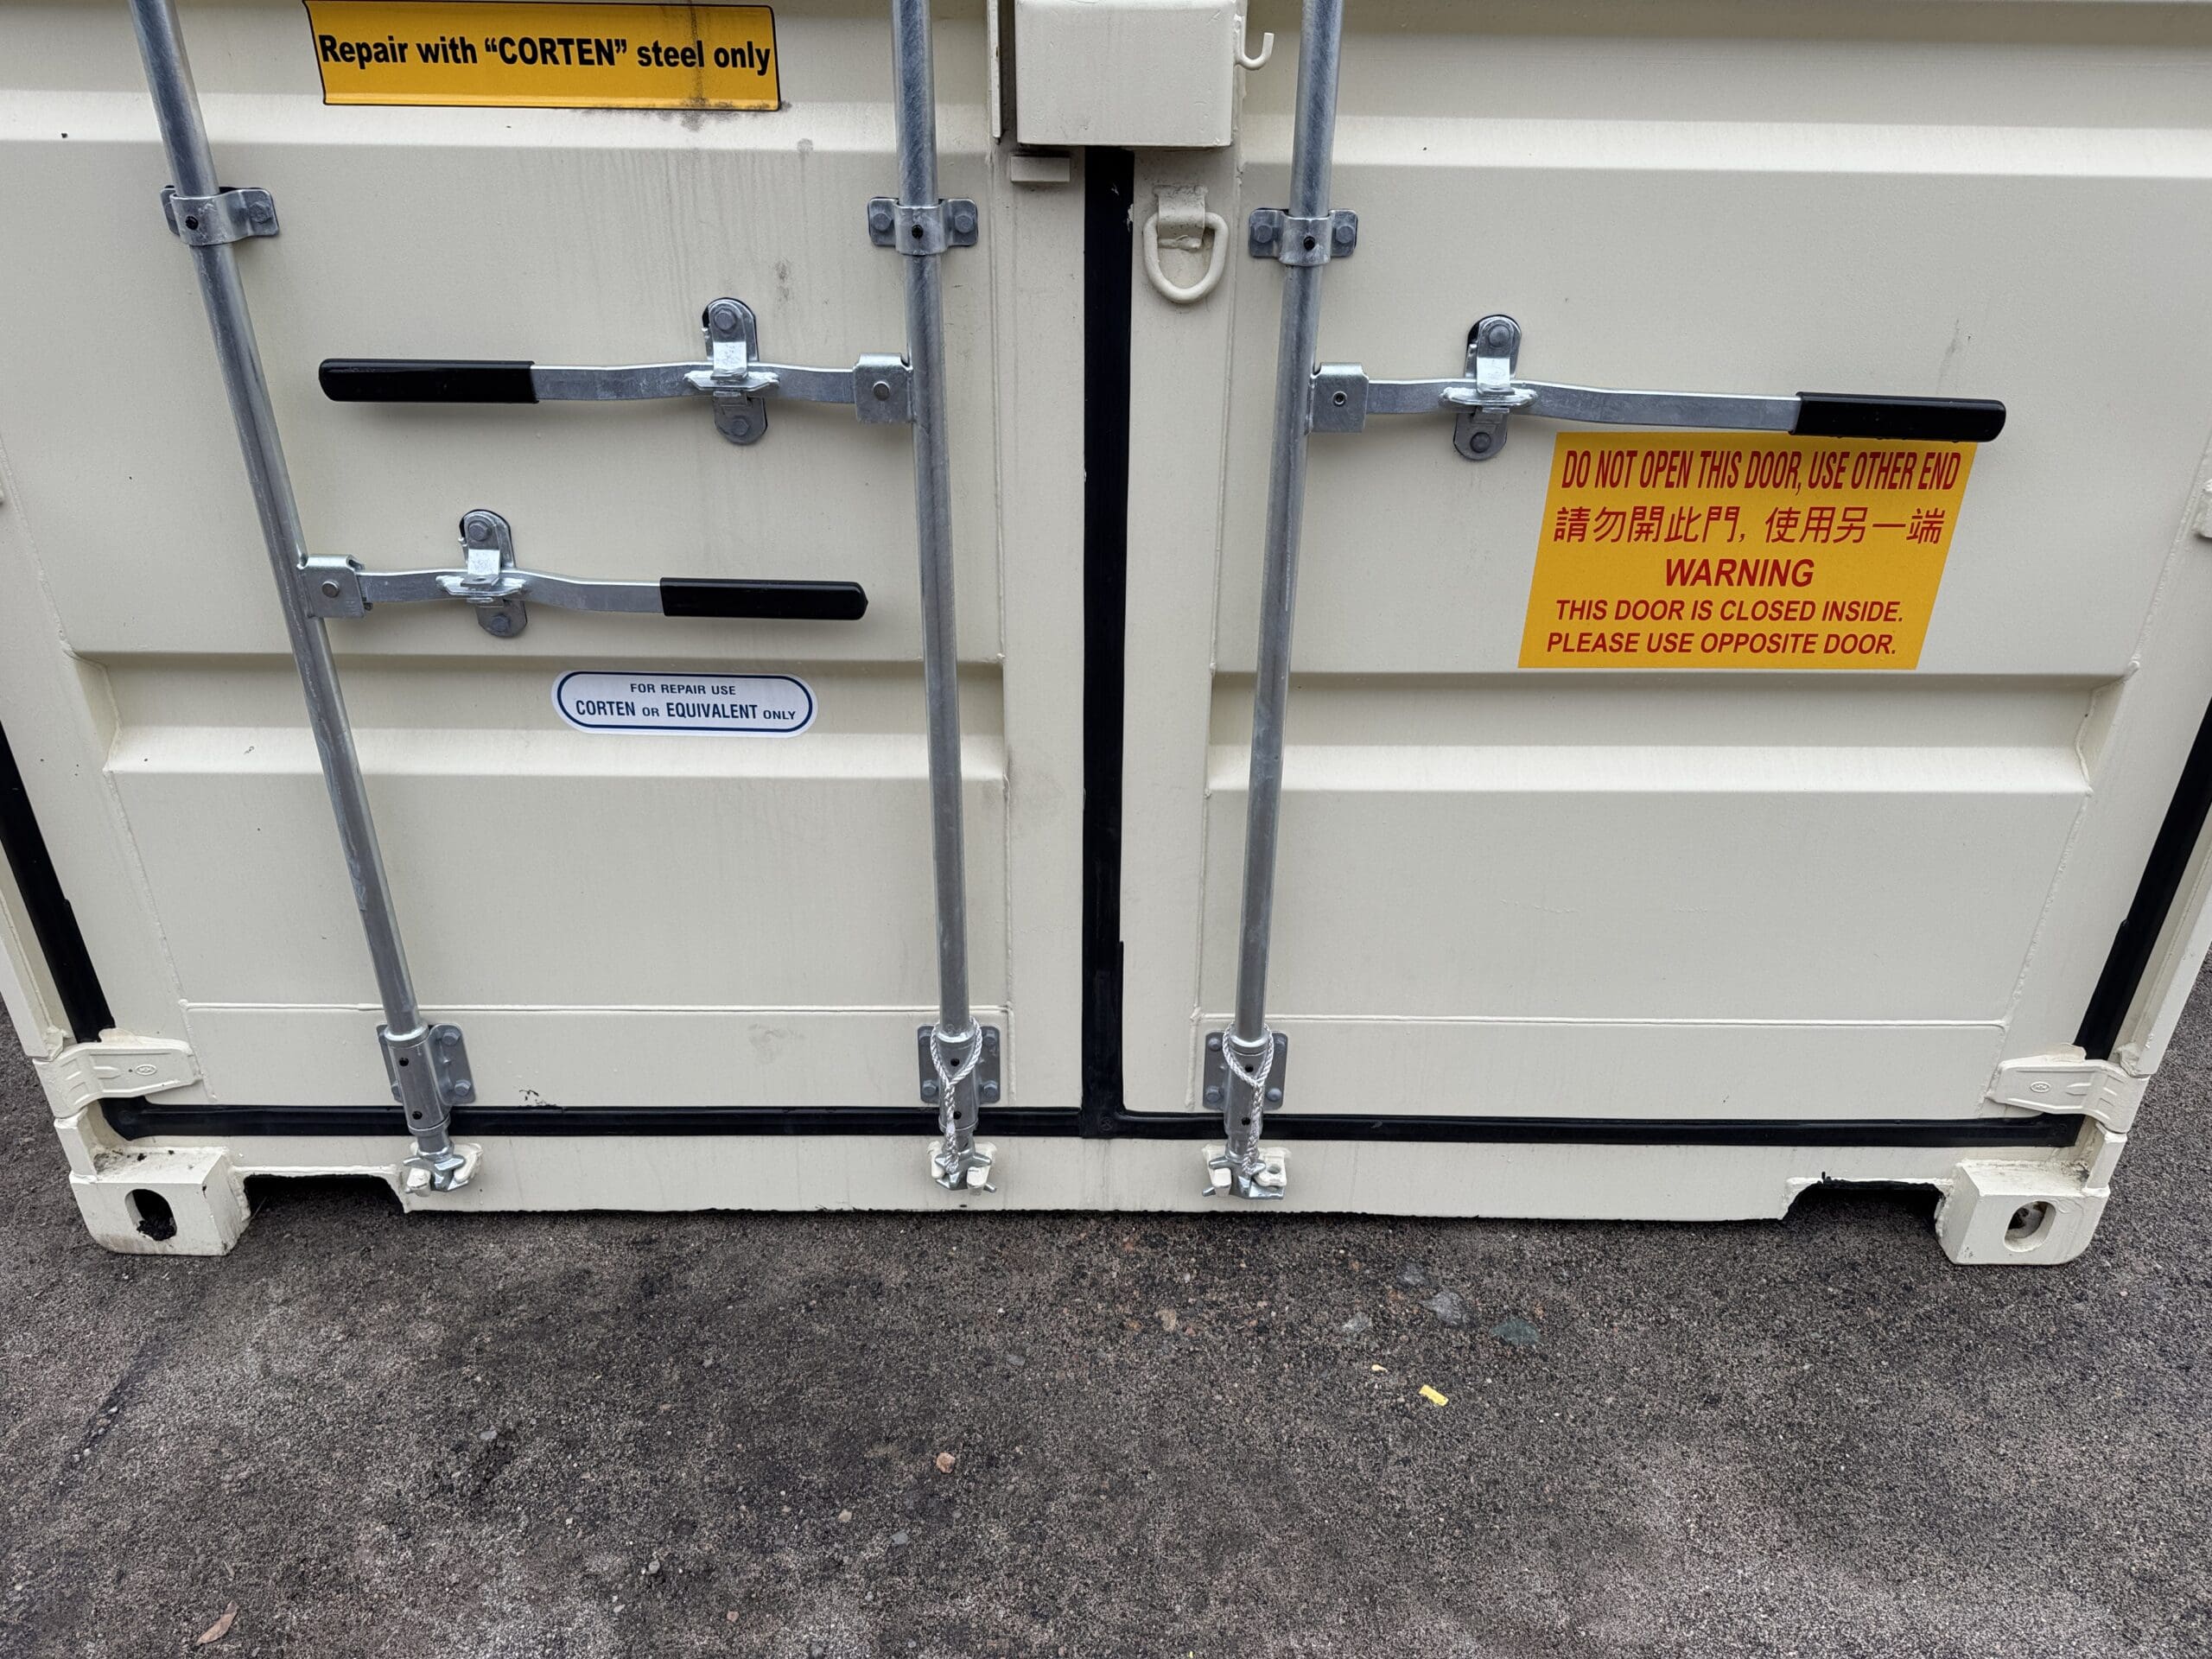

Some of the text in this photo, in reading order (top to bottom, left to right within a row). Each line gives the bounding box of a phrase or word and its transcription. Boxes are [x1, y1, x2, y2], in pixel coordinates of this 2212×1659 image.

[318, 34, 771, 76] Repair with “CORTEN” steel only
[1561, 449, 1961, 495] DO NOT OPEN THIS DOOR, USE OTHER END
[1666, 558, 1815, 588] WARNING
[1556, 599, 1904, 622] THIS DOOR IS CLOSED INSIDE.
[1547, 632, 1897, 654] PLEASE USE OPPOSITE DOOR.
[630, 683, 736, 696] FOR REPAIR USE
[575, 699, 797, 721] CORTEN OR EQUIVALENT ONLY
